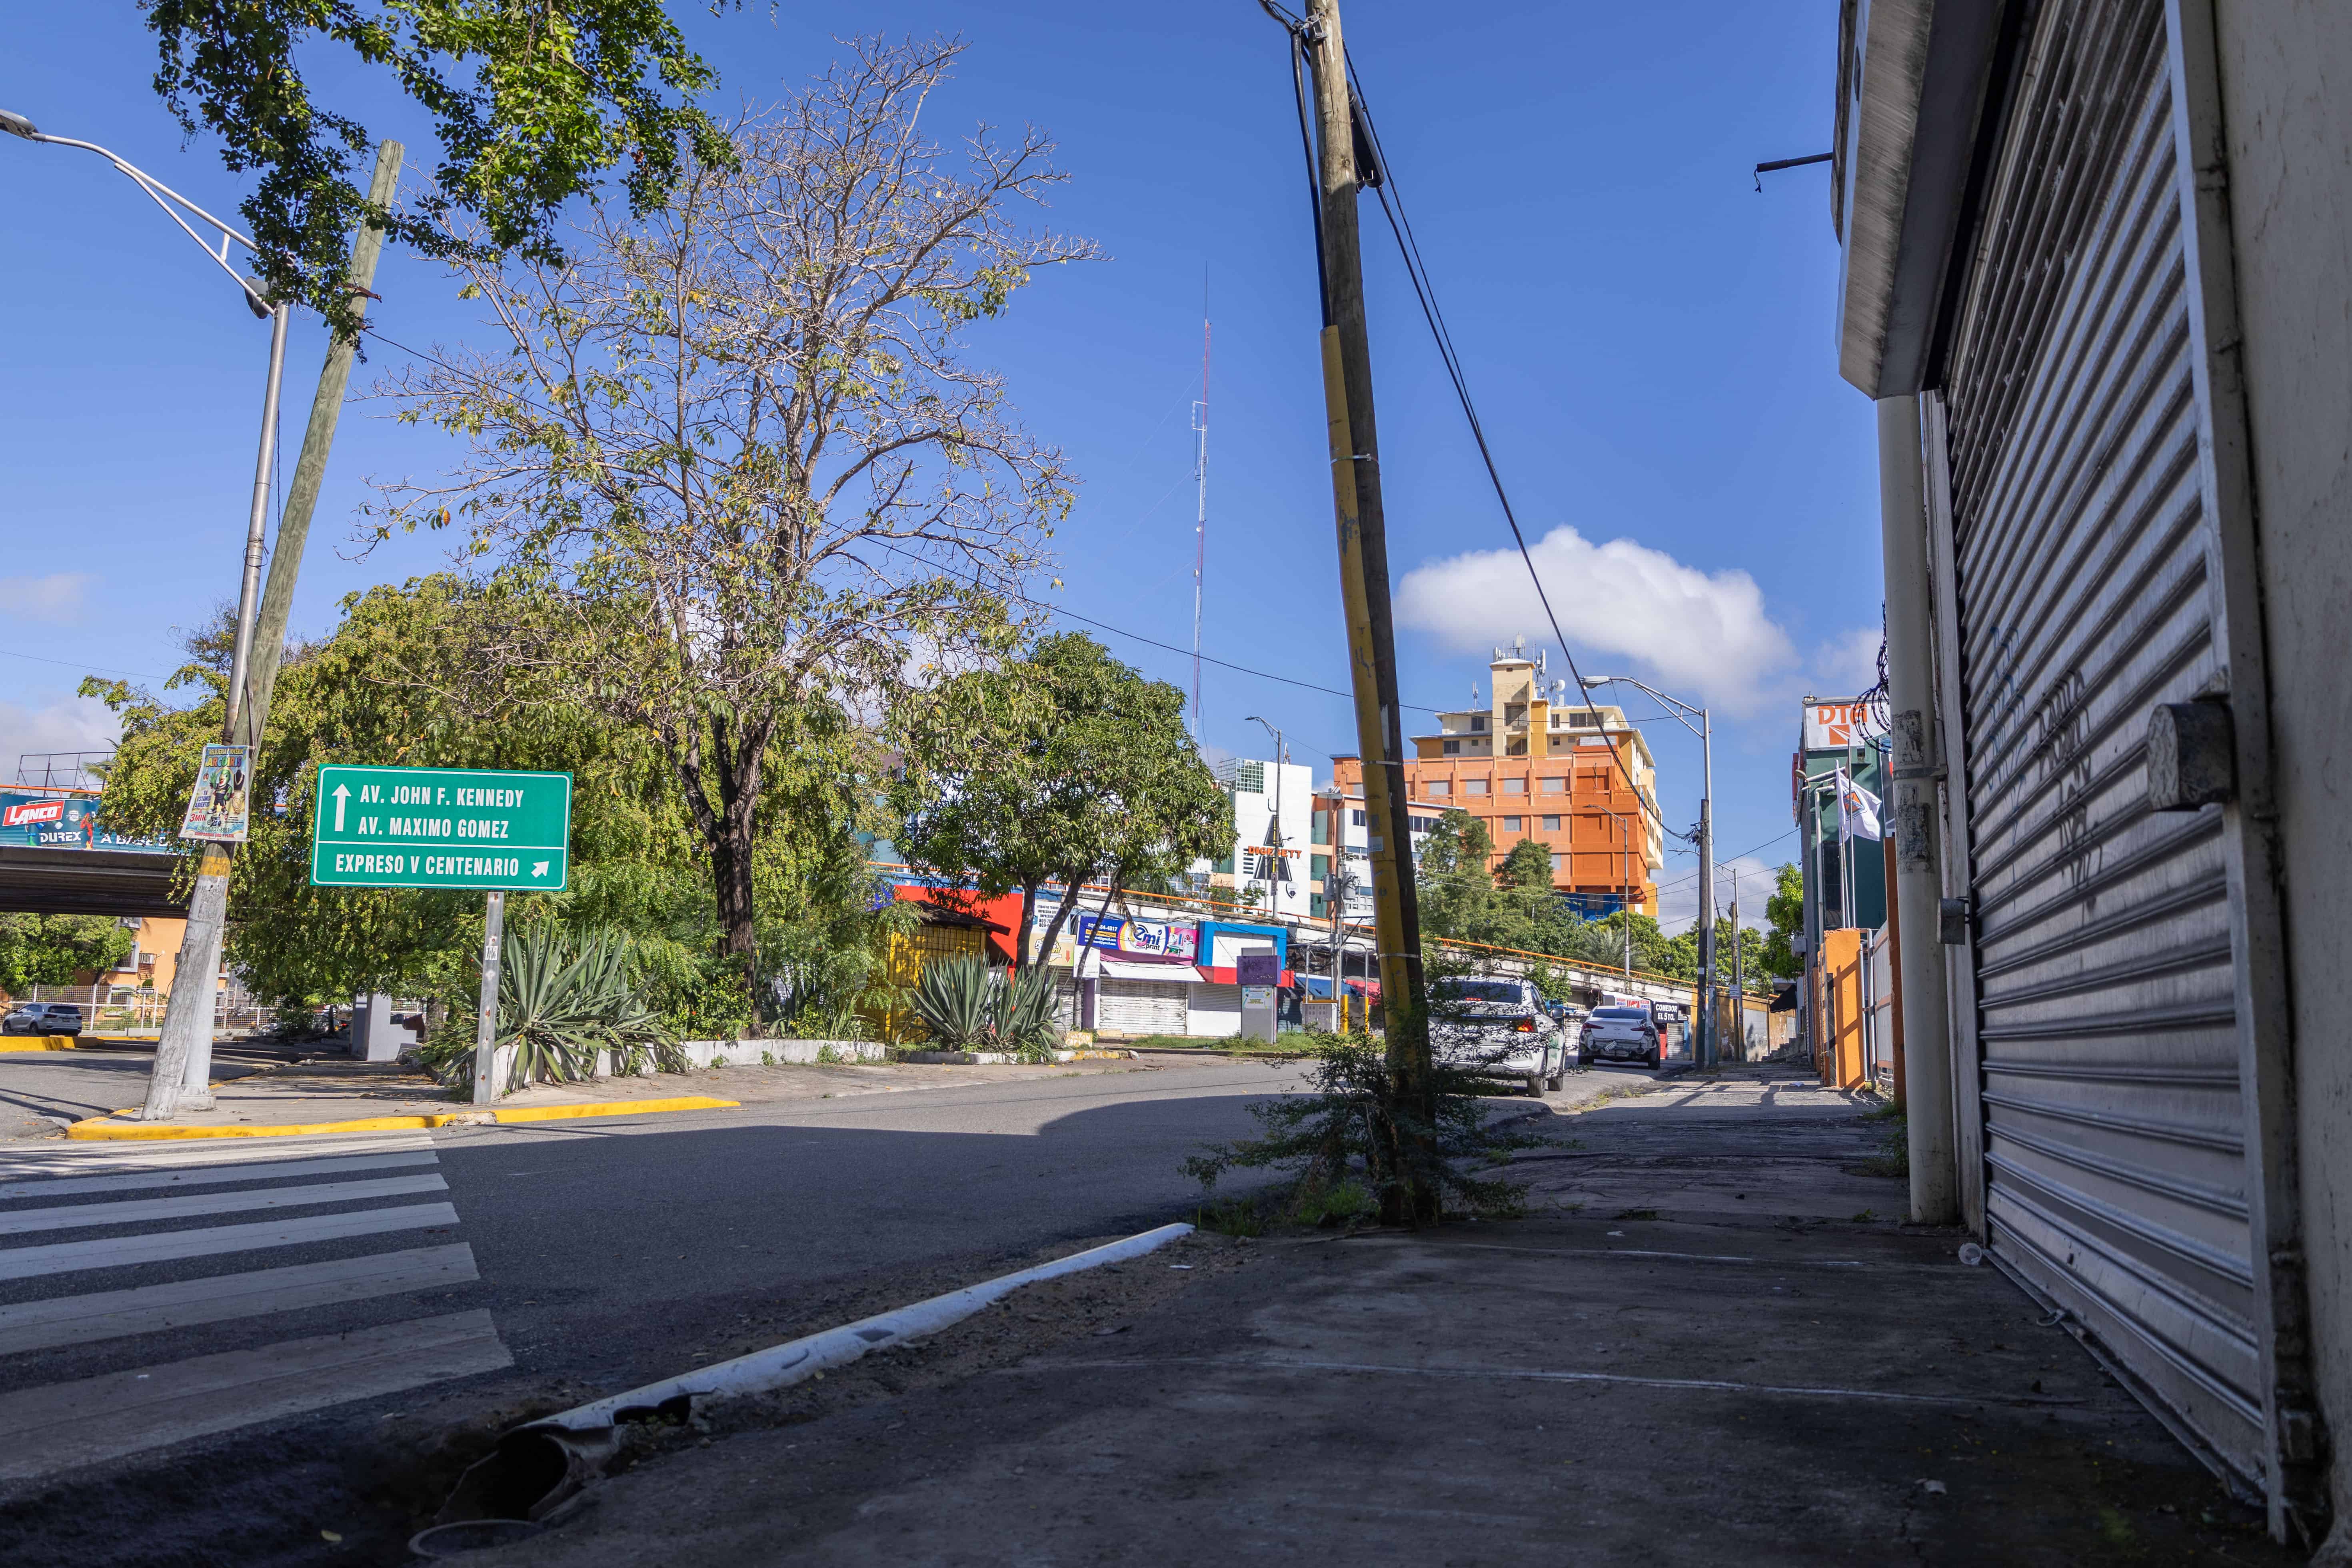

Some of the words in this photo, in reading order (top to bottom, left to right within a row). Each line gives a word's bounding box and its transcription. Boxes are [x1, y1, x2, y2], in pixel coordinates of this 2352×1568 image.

[205, 756, 242, 767] ARCOIRIS
[360, 785, 384, 803] AV.
[391, 786, 430, 804] JOHN
[437, 788, 450, 805] F.
[457, 788, 524, 807] KENNEDY
[9, 805, 58, 825] LANCO
[39, 831, 82, 843] DUREX
[358, 817, 382, 835] AV.
[390, 818, 451, 837] MAXIMO
[458, 819, 508, 838] GOMEZ
[336, 854, 404, 873] EXPRESO
[411, 856, 420, 873] V
[426, 856, 518, 876] CENTENARIO
[1656, 1004, 1677, 1013] COMEDOR
